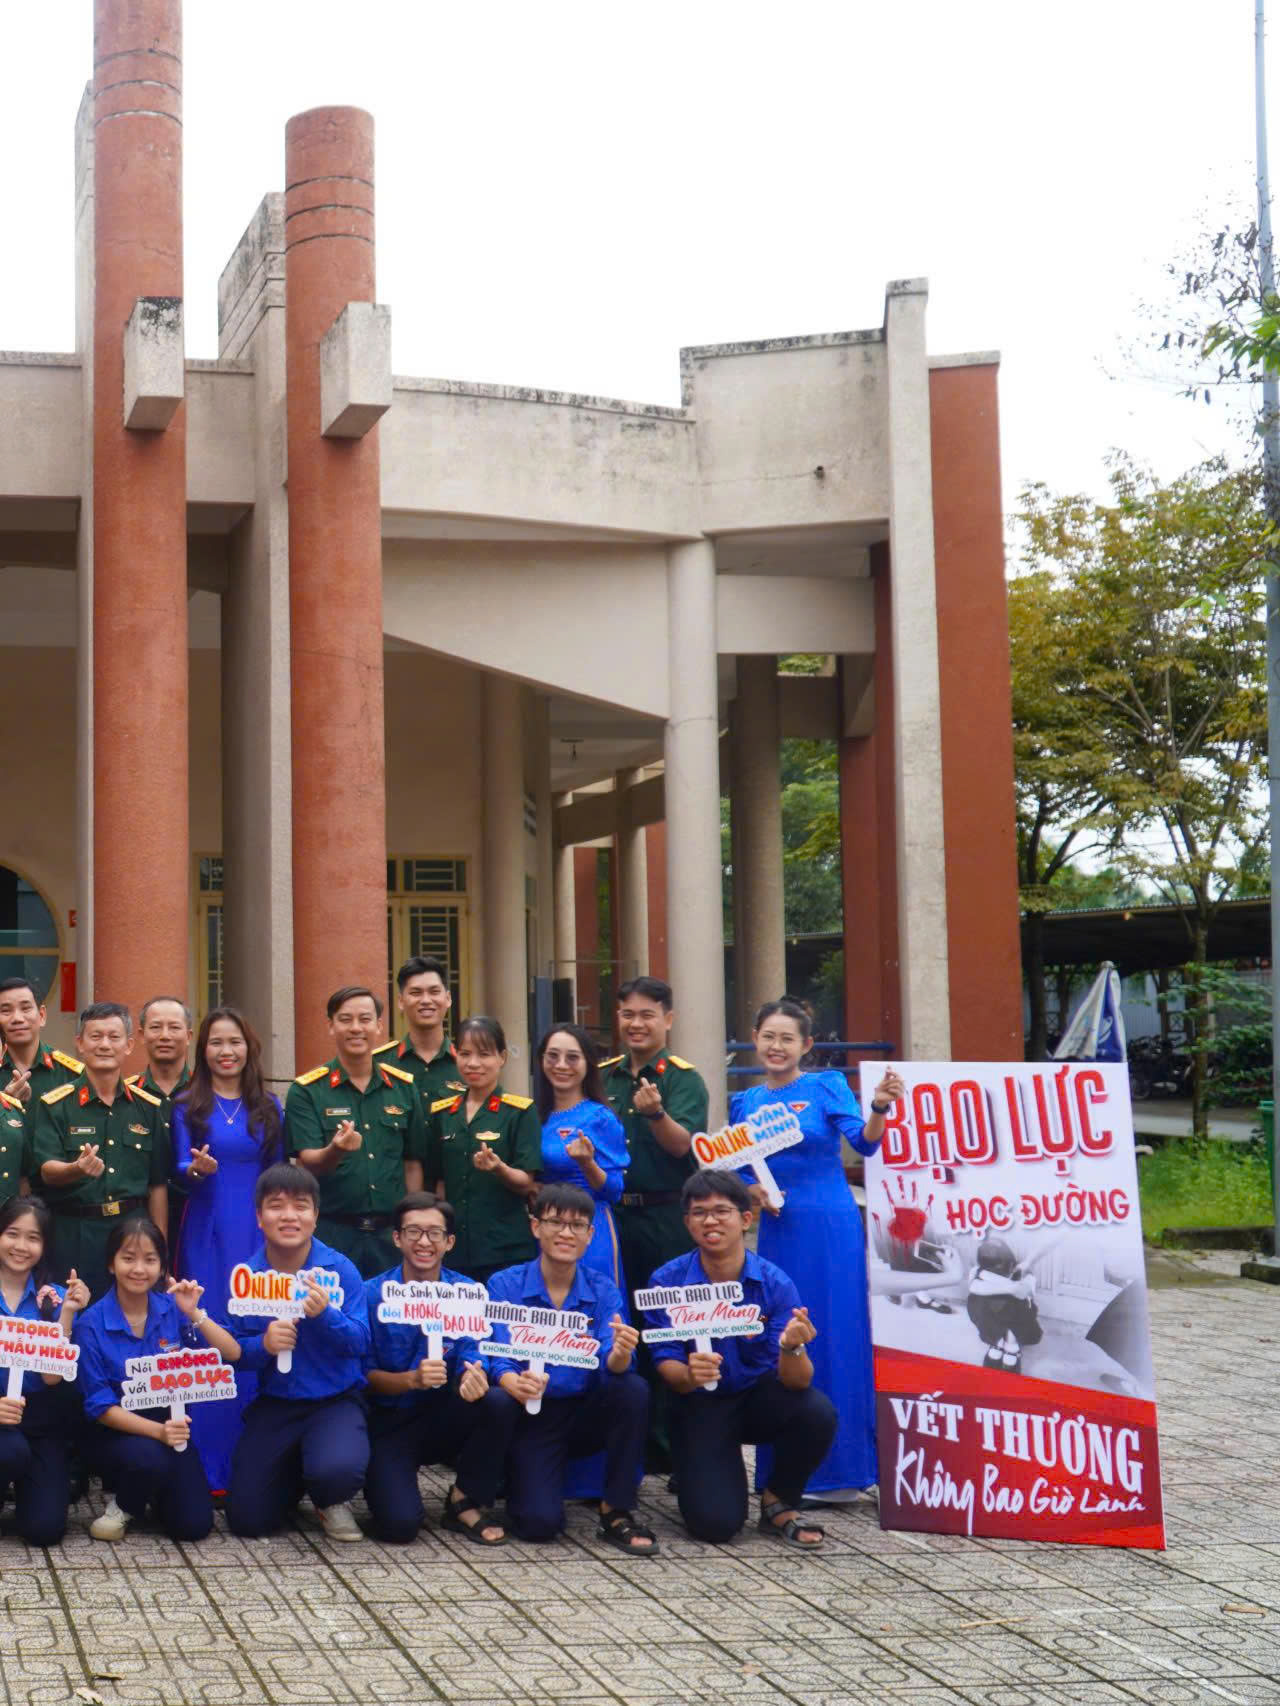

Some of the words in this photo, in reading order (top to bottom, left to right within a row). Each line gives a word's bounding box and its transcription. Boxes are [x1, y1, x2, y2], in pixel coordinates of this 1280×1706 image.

[754, 1117, 797, 1142] MINH
[881, 1080, 995, 1182] BẠO
[1004, 1065, 1113, 1175] LỰC
[946, 1195, 1011, 1237] HỌC
[1019, 1183, 1130, 1226] ĐƯỜNG
[410, 1286, 432, 1298] Sinh
[458, 1287, 485, 1300] Minh
[638, 1289, 681, 1307] KHÔNG
[485, 1303, 527, 1322] KHÔNG
[6, 1320, 60, 1340] TRỌNG
[131, 1362, 152, 1374] Nói
[157, 1352, 219, 1372] KHÔNG
[128, 1382, 147, 1395] với
[150, 1372, 193, 1394] BẠO
[195, 1368, 233, 1389] LỰC
[889, 1390, 964, 1442] VẾT
[975, 1407, 1144, 1495] THƯƠNG
[895, 1432, 975, 1536] Không
[982, 1463, 1025, 1514] Bao
[1030, 1476, 1075, 1514] Giờ
[1080, 1487, 1146, 1514] Lành
